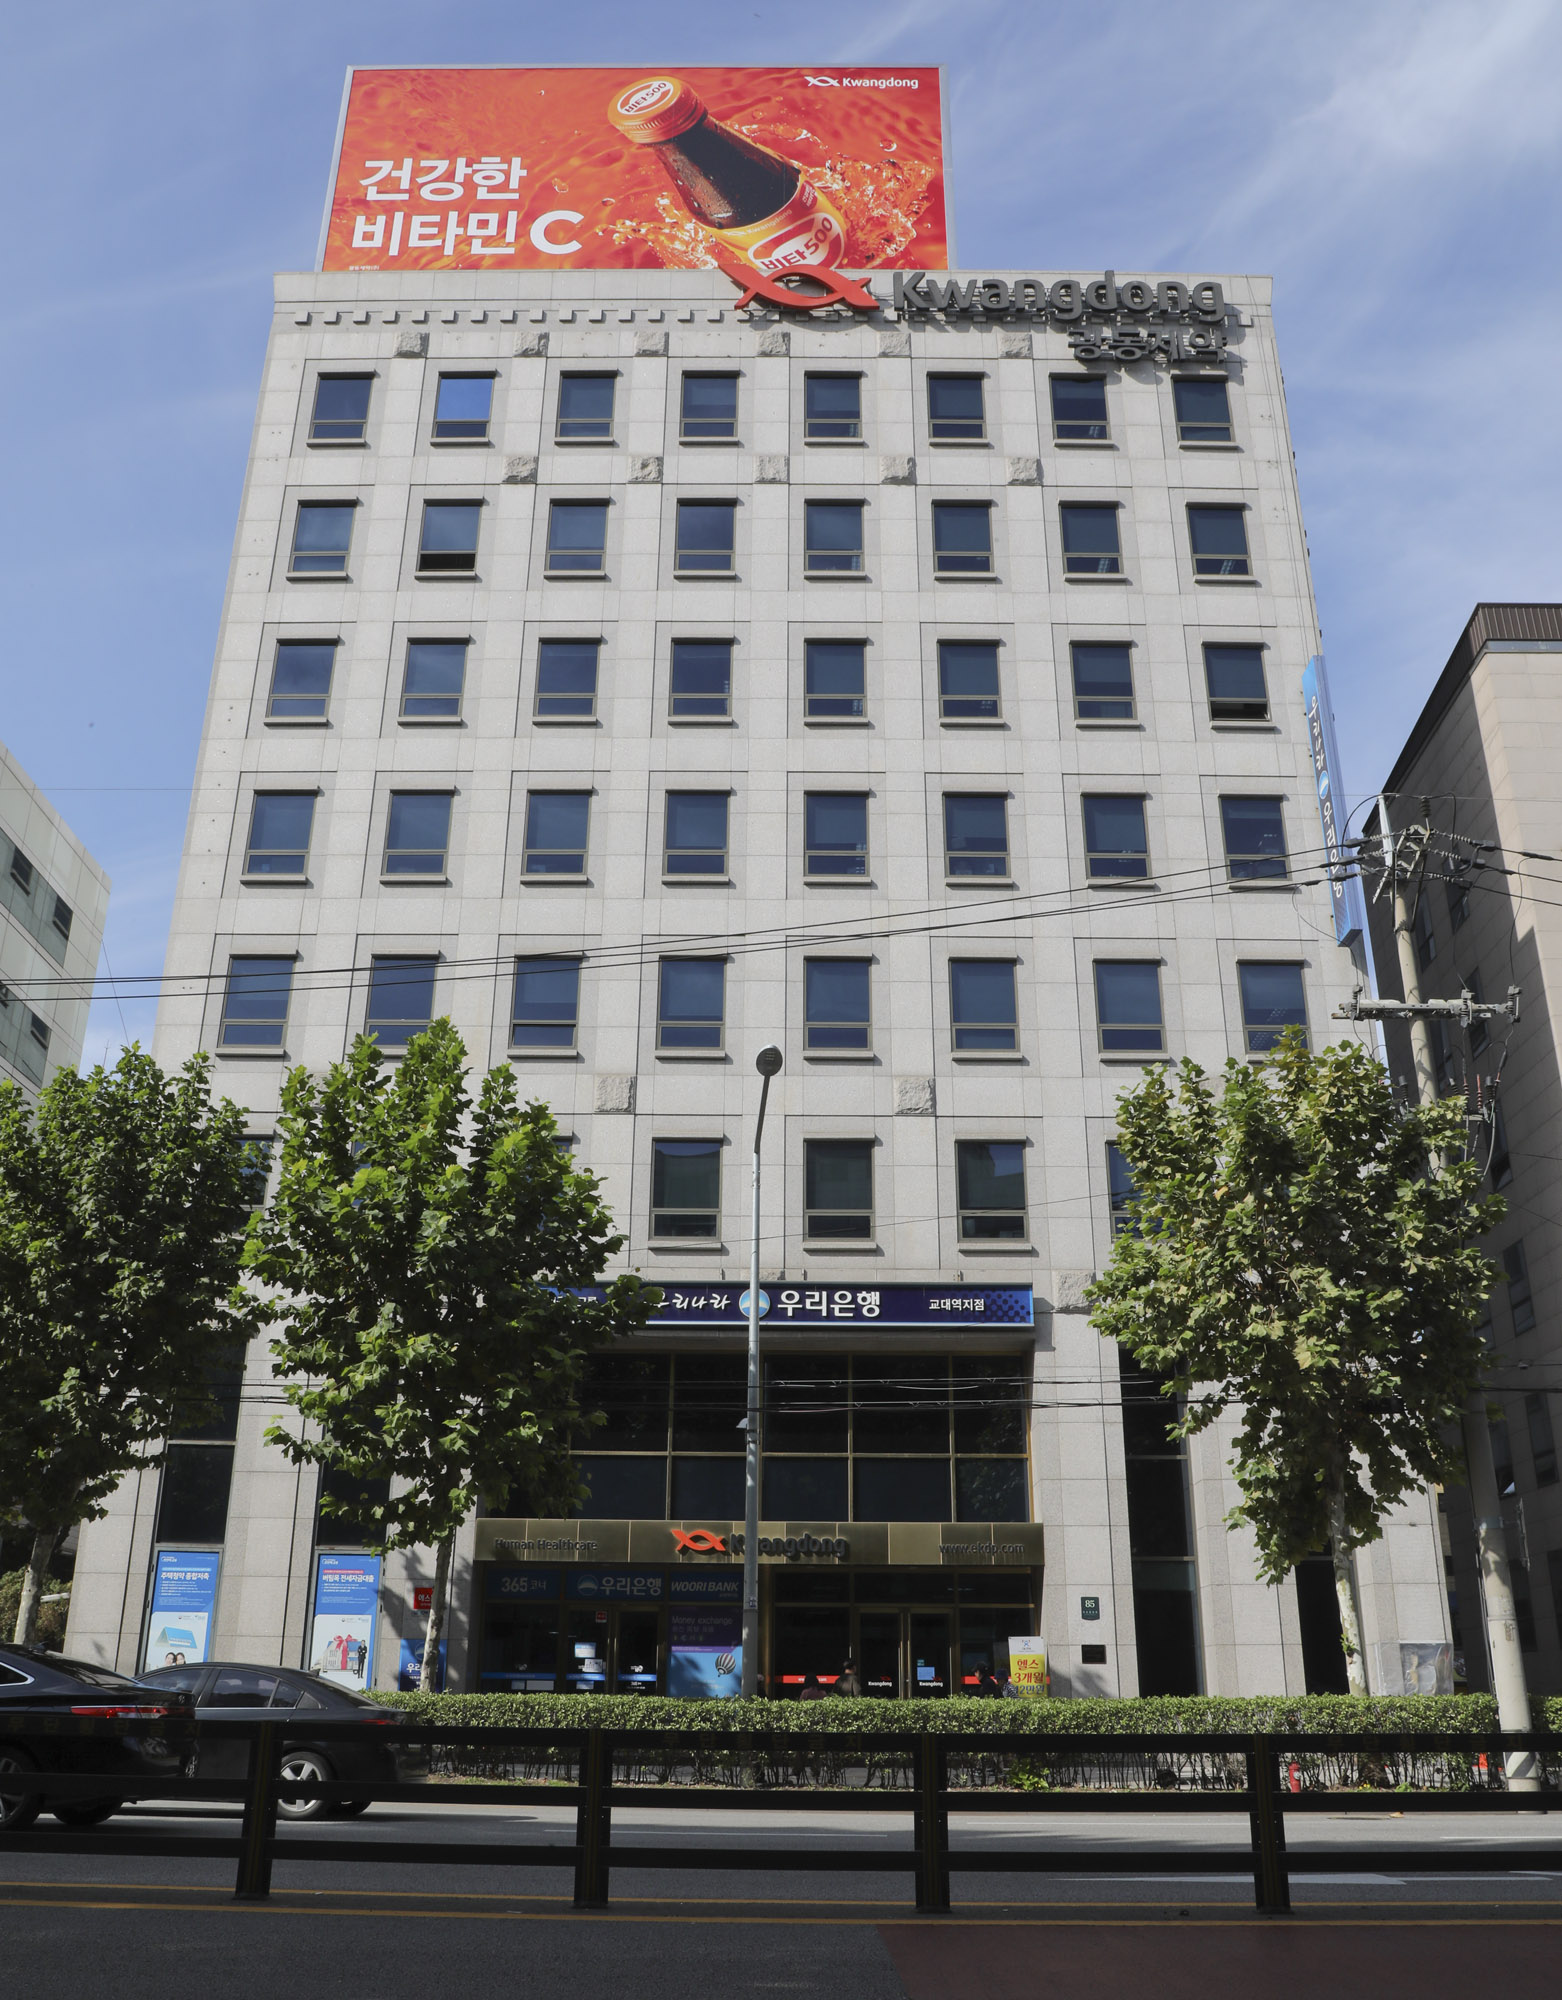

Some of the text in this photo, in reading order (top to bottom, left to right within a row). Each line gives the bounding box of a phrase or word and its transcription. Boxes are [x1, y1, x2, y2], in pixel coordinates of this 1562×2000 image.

[842, 77, 919, 90] Kwangdong
[624, 82, 667, 113] 비타500
[359, 157, 527, 201] 건강한
[746, 209, 793, 235] Kwangdong
[352, 210, 584, 256] 비타민 C
[760, 217, 833, 270] 비타500
[893, 269, 1225, 323] Kwangdong
[1068, 327, 1229, 363] 광동제약
[777, 1289, 881, 1318] 우리은행
[928, 1298, 985, 1312] 교대역지점
[495, 1538, 598, 1551] Human Healthcare
[730, 1533, 847, 1558] Kangdong
[939, 1542, 1025, 1557] www.ekdp.com
[500, 1576, 528, 1593] 365
[600, 1577, 663, 1597] 우리은행
[671, 1581, 741, 1592] WOORI BANK
[1085, 1599, 1096, 1608] 85
[671, 1616, 734, 1626] Money exchange
[1017, 1659, 1039, 1671] 헬스
[1014, 1672, 1044, 1684] 3개월
